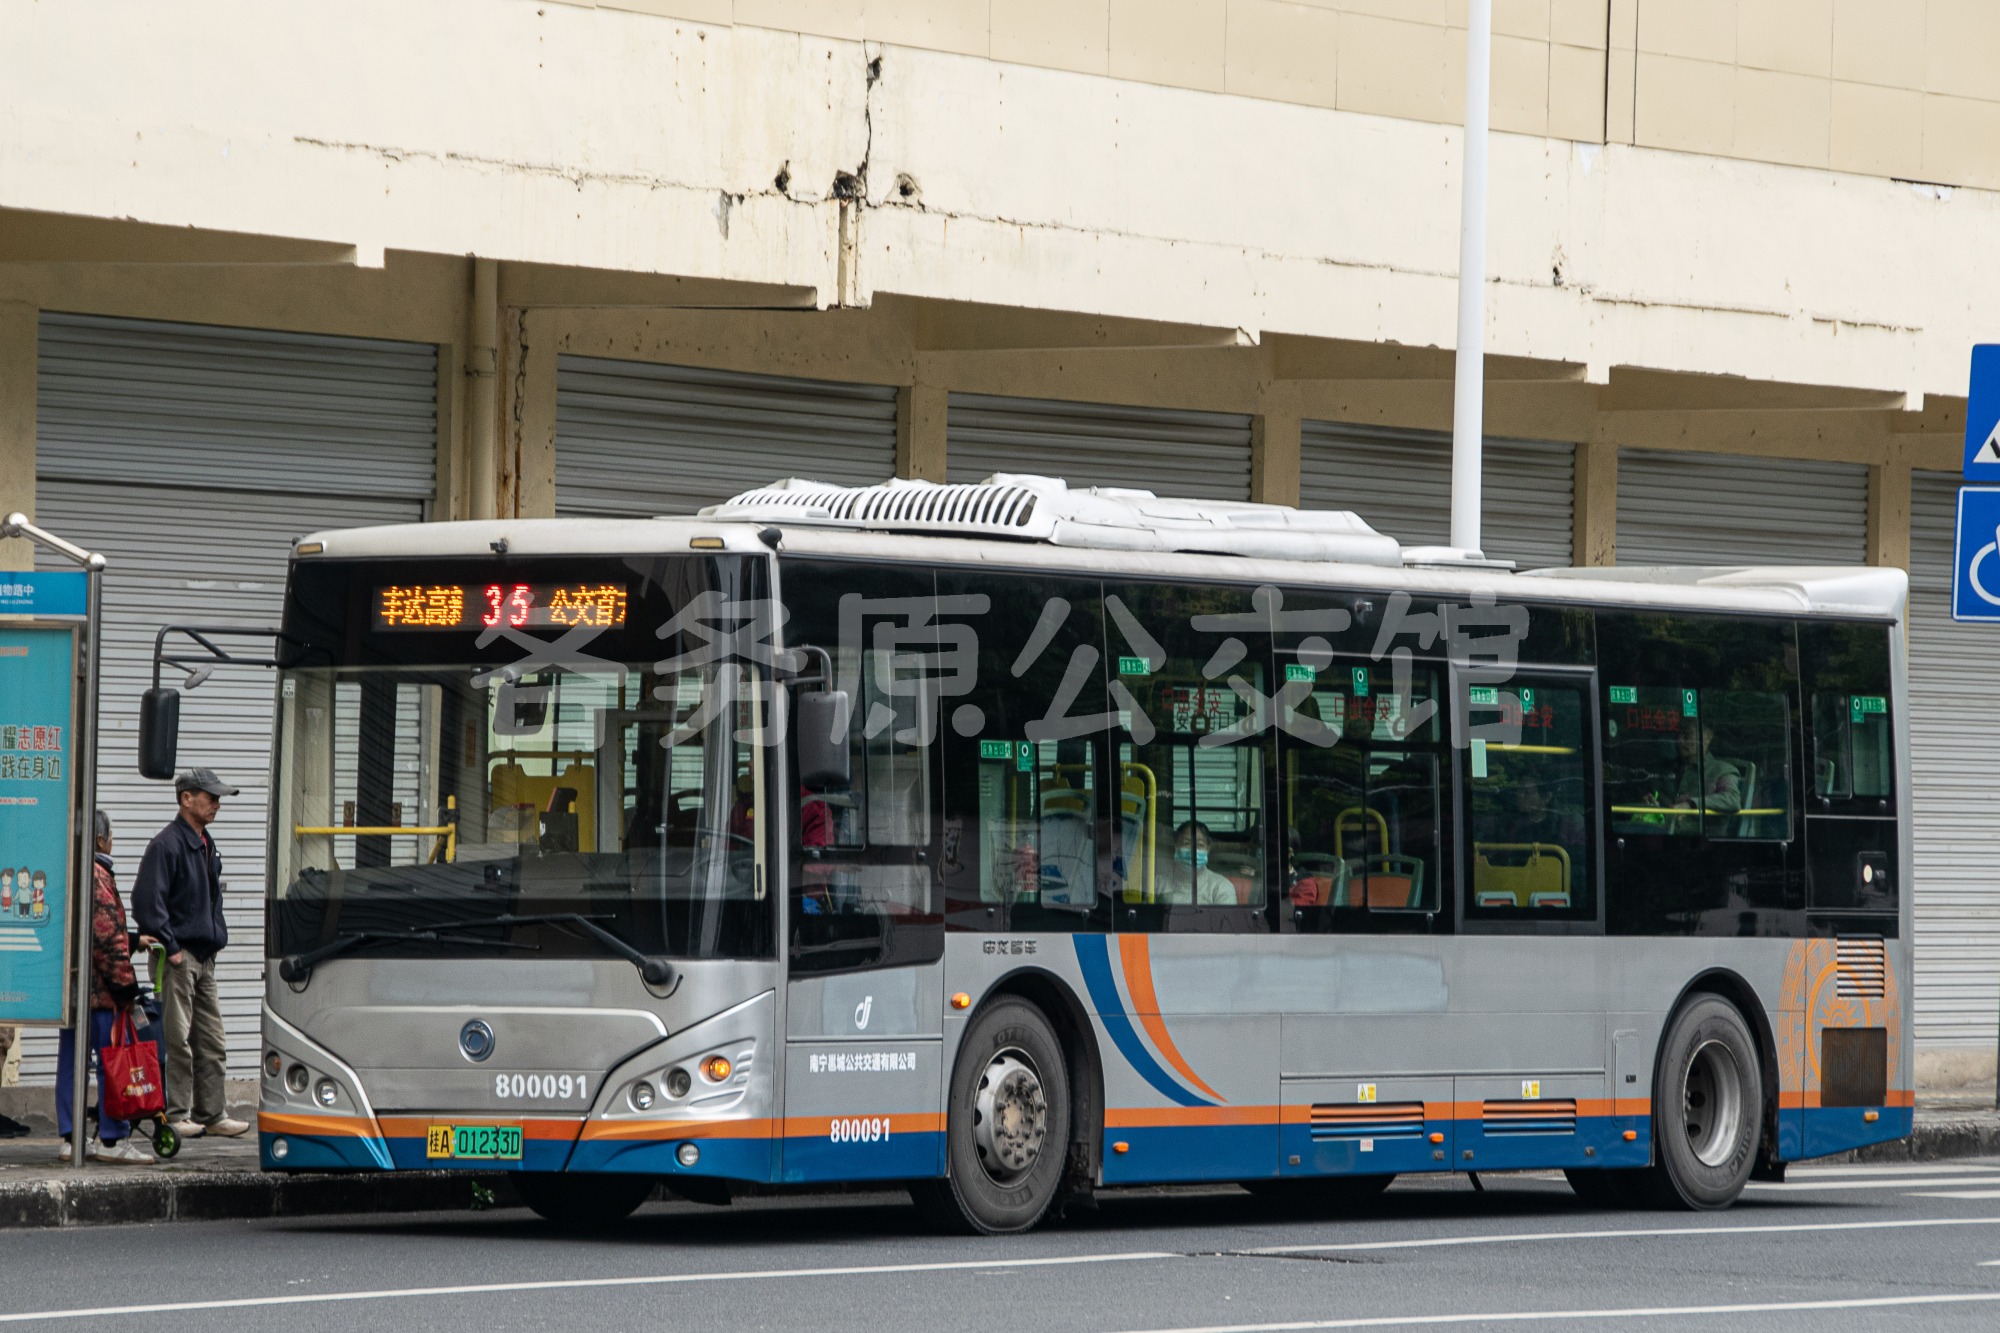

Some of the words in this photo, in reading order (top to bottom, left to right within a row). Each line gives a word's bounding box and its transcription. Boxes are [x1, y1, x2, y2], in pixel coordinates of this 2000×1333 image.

[0, 584, 34, 597] 物路中
[483, 585, 529, 626] 35
[495, 1073, 587, 1099] 800091
[830, 1117, 890, 1143] 800091
